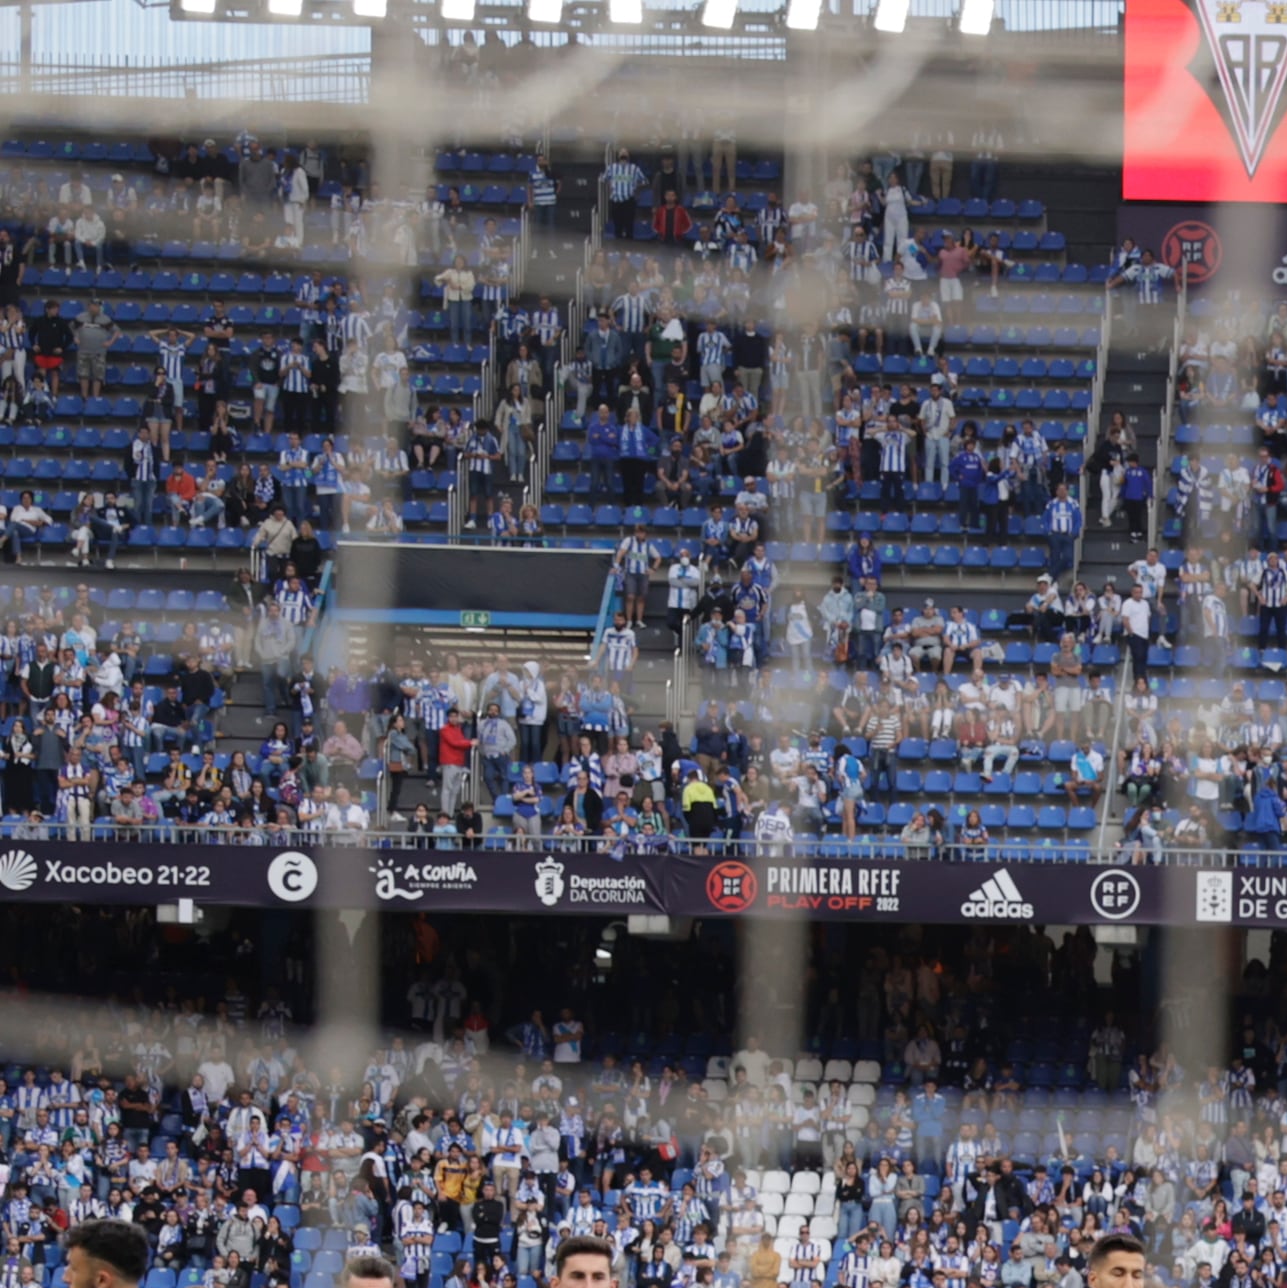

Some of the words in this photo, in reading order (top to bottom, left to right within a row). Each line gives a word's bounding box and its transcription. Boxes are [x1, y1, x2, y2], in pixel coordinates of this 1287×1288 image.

[45, 859, 153, 885] Xacobeo
[404, 864, 419, 880] A
[570, 874, 645, 893] Deputación
[767, 868, 853, 894] PRIMERA
[859, 869, 900, 895] RFEF
[1102, 881, 1128, 893] RF
[570, 890, 586, 902] DA
[590, 886, 646, 903] CORUÑA
[1102, 895, 1128, 908] EF
[767, 896, 820, 909] PLAY
[828, 897, 871, 910] OFF
[876, 896, 899, 912] 2022
[961, 898, 1034, 919] adidas
[1240, 898, 1267, 918] DE
